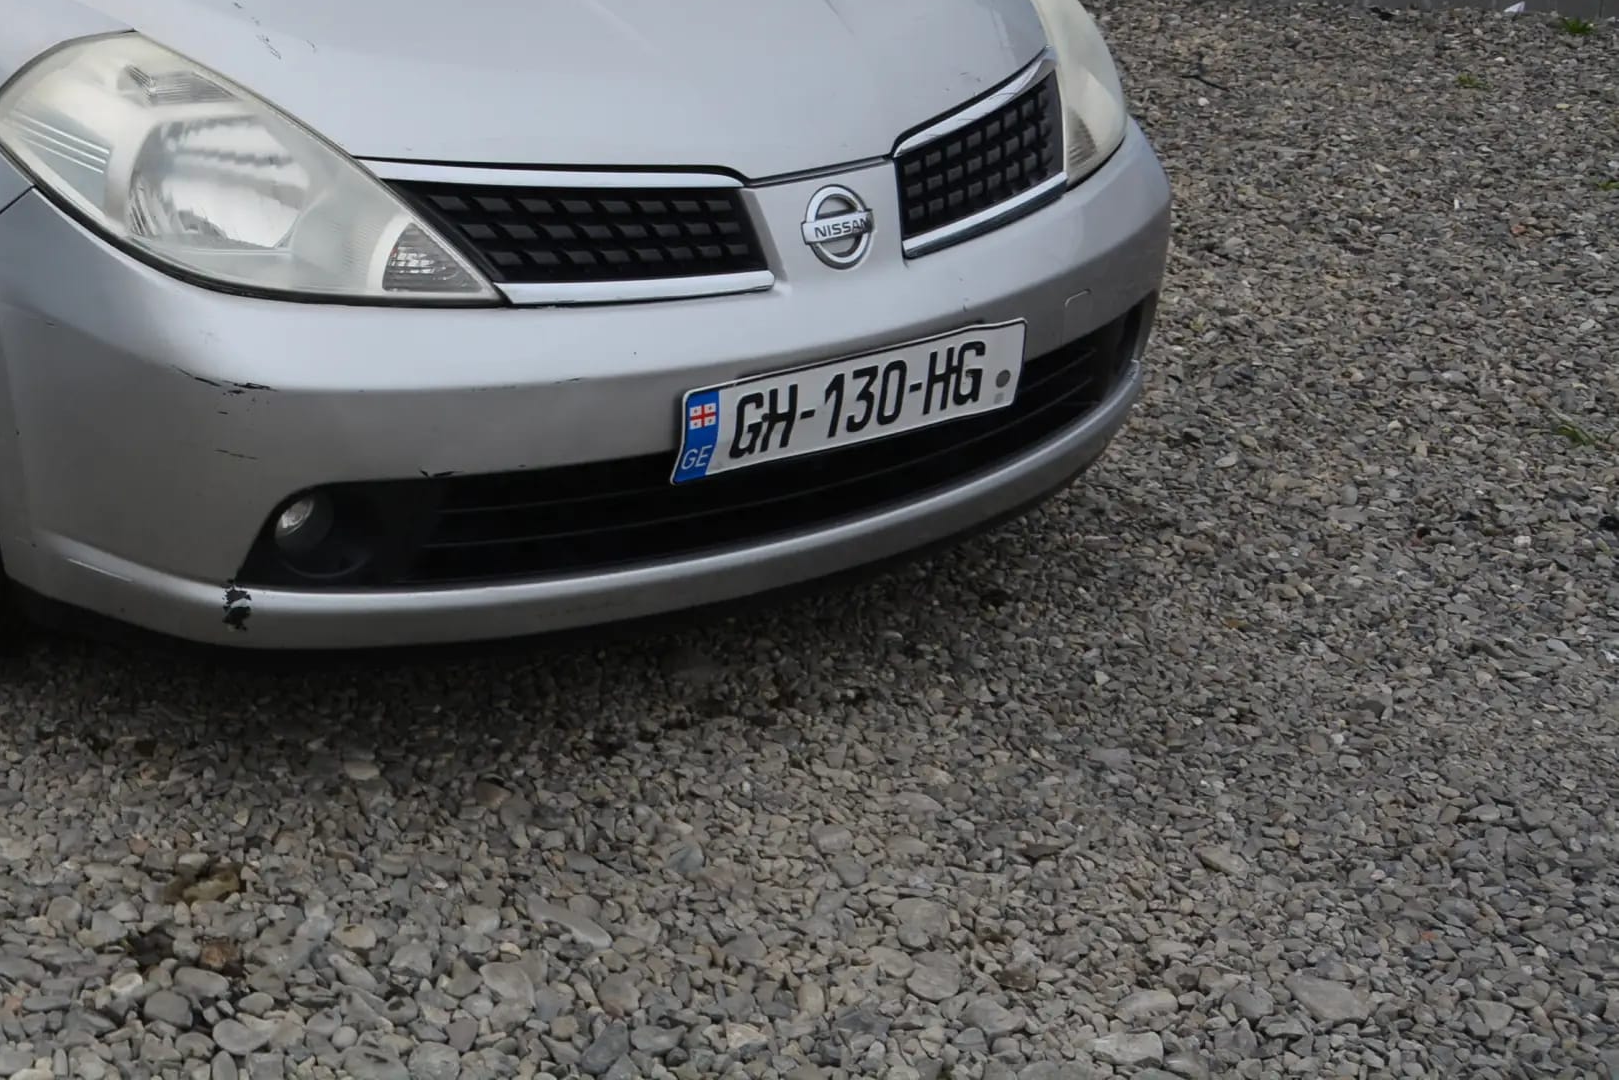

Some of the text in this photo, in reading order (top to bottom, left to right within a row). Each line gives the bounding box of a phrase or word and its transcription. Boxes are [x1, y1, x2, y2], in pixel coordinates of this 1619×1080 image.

[814, 218, 870, 238] NISSAN
[729, 340, 986, 460] GH-130-HG
[682, 444, 713, 470] GE
